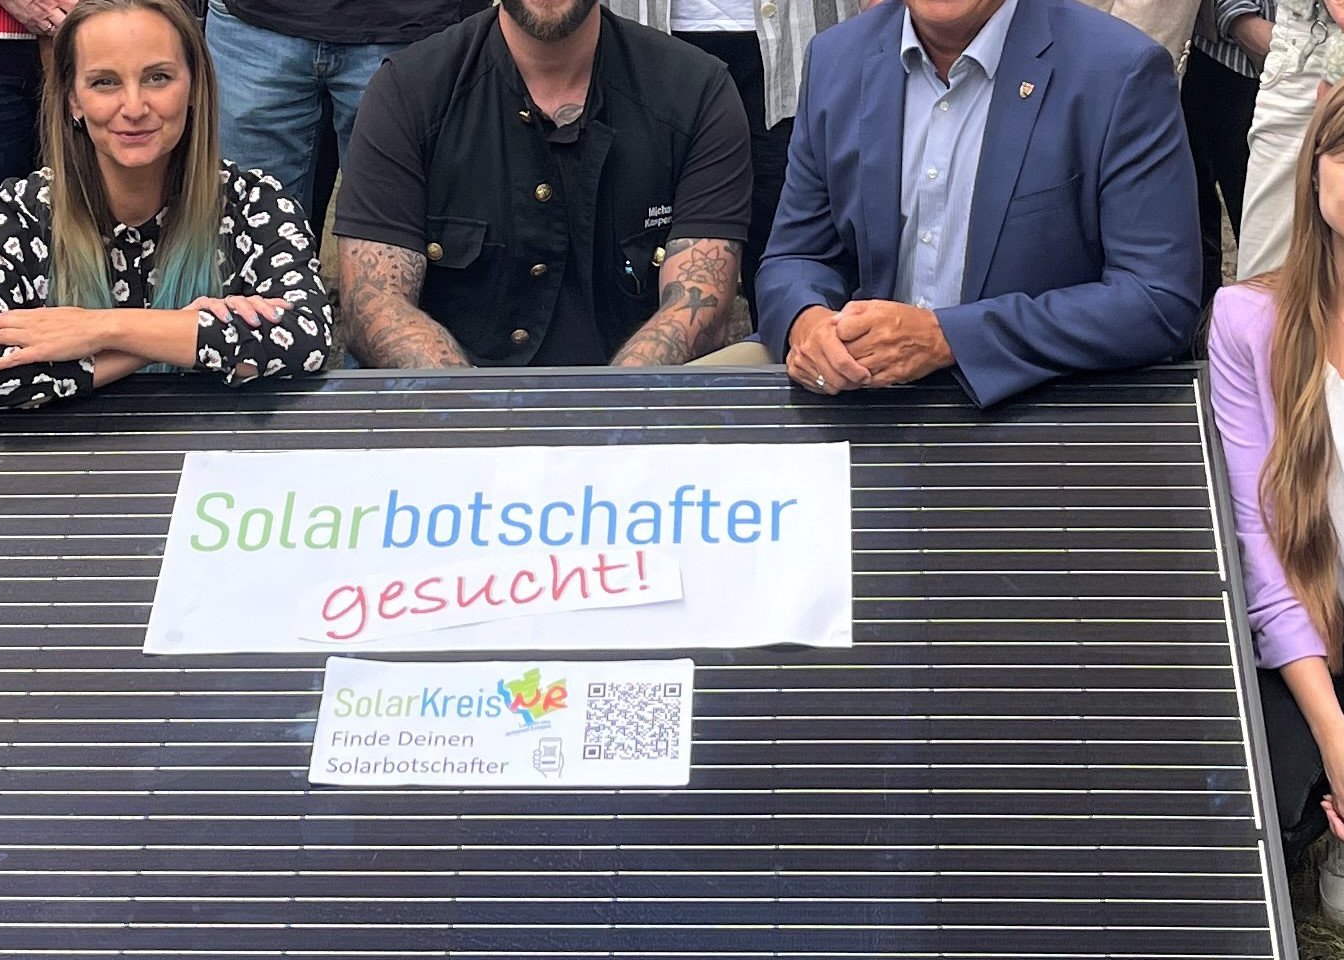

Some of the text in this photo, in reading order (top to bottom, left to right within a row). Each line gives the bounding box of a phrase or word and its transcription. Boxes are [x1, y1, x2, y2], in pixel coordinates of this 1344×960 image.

[188, 484, 799, 553] Solarbotschafter
[321, 550, 650, 641] gesucht!
[333, 686, 503, 719] SolarKreis
[330, 730, 475, 748] Finde Deinen
[325, 755, 510, 775] Solarbotschafter
